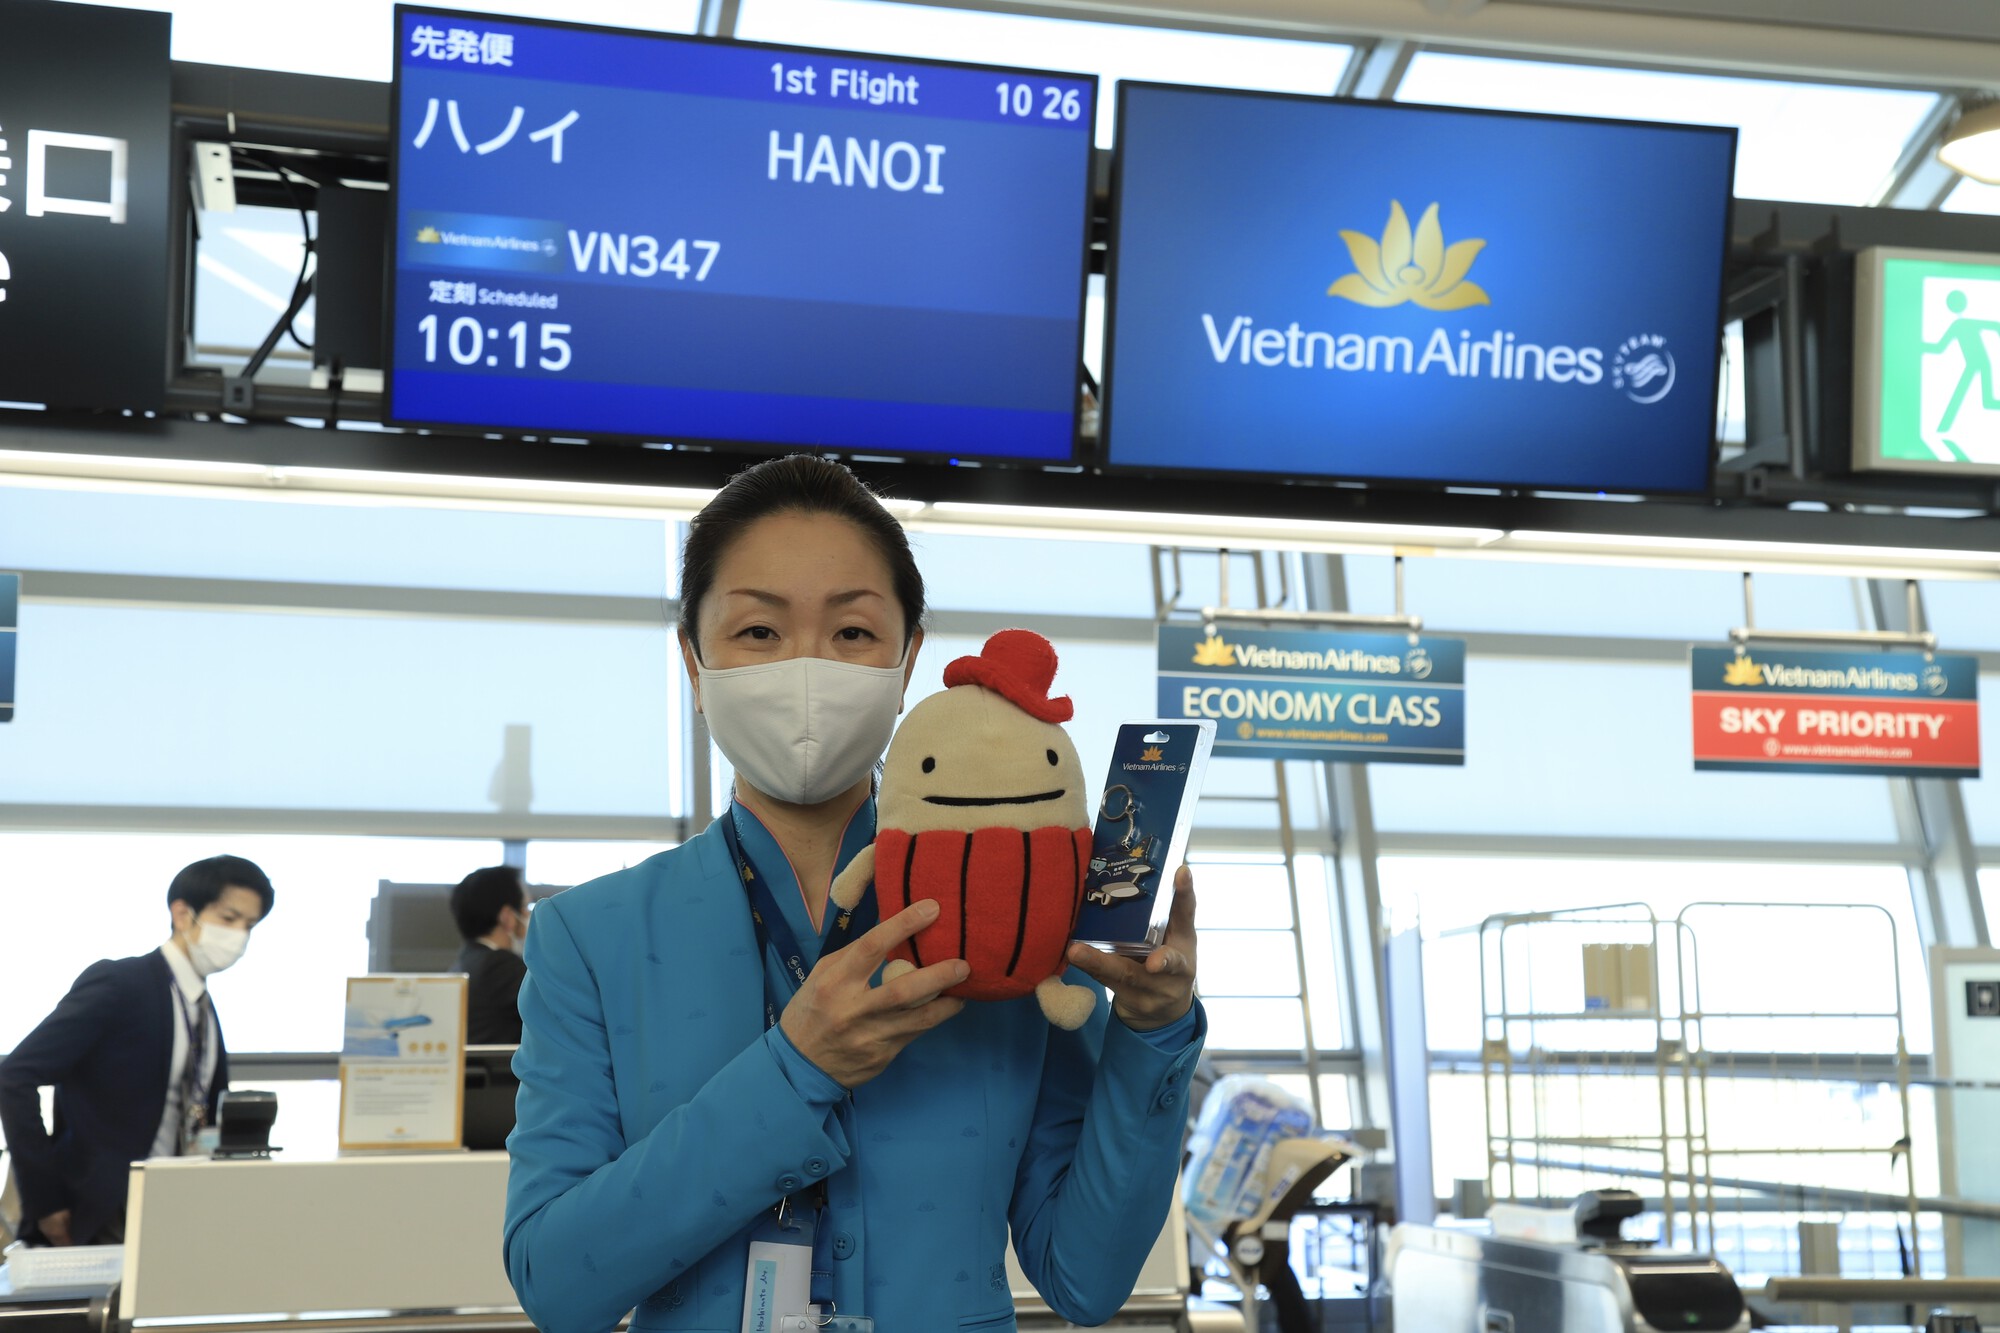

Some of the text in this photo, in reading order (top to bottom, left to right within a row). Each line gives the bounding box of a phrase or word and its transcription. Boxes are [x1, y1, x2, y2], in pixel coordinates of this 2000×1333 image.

[411, 25, 514, 67] 先発便
[771, 62, 919, 105] 1st Flight
[996, 82, 1081, 121] 10 26
[413, 98, 580, 164] ハノイ
[767, 130, 946, 194] HANOI
[568, 229, 721, 282] VN347
[429, 280, 558, 309] 定刻 Scheduled
[418, 314, 572, 371] 10:15
[1183, 686, 1441, 727] ECONOMY CLASS
[1720, 706, 1945, 739] SKY PRIORITY
